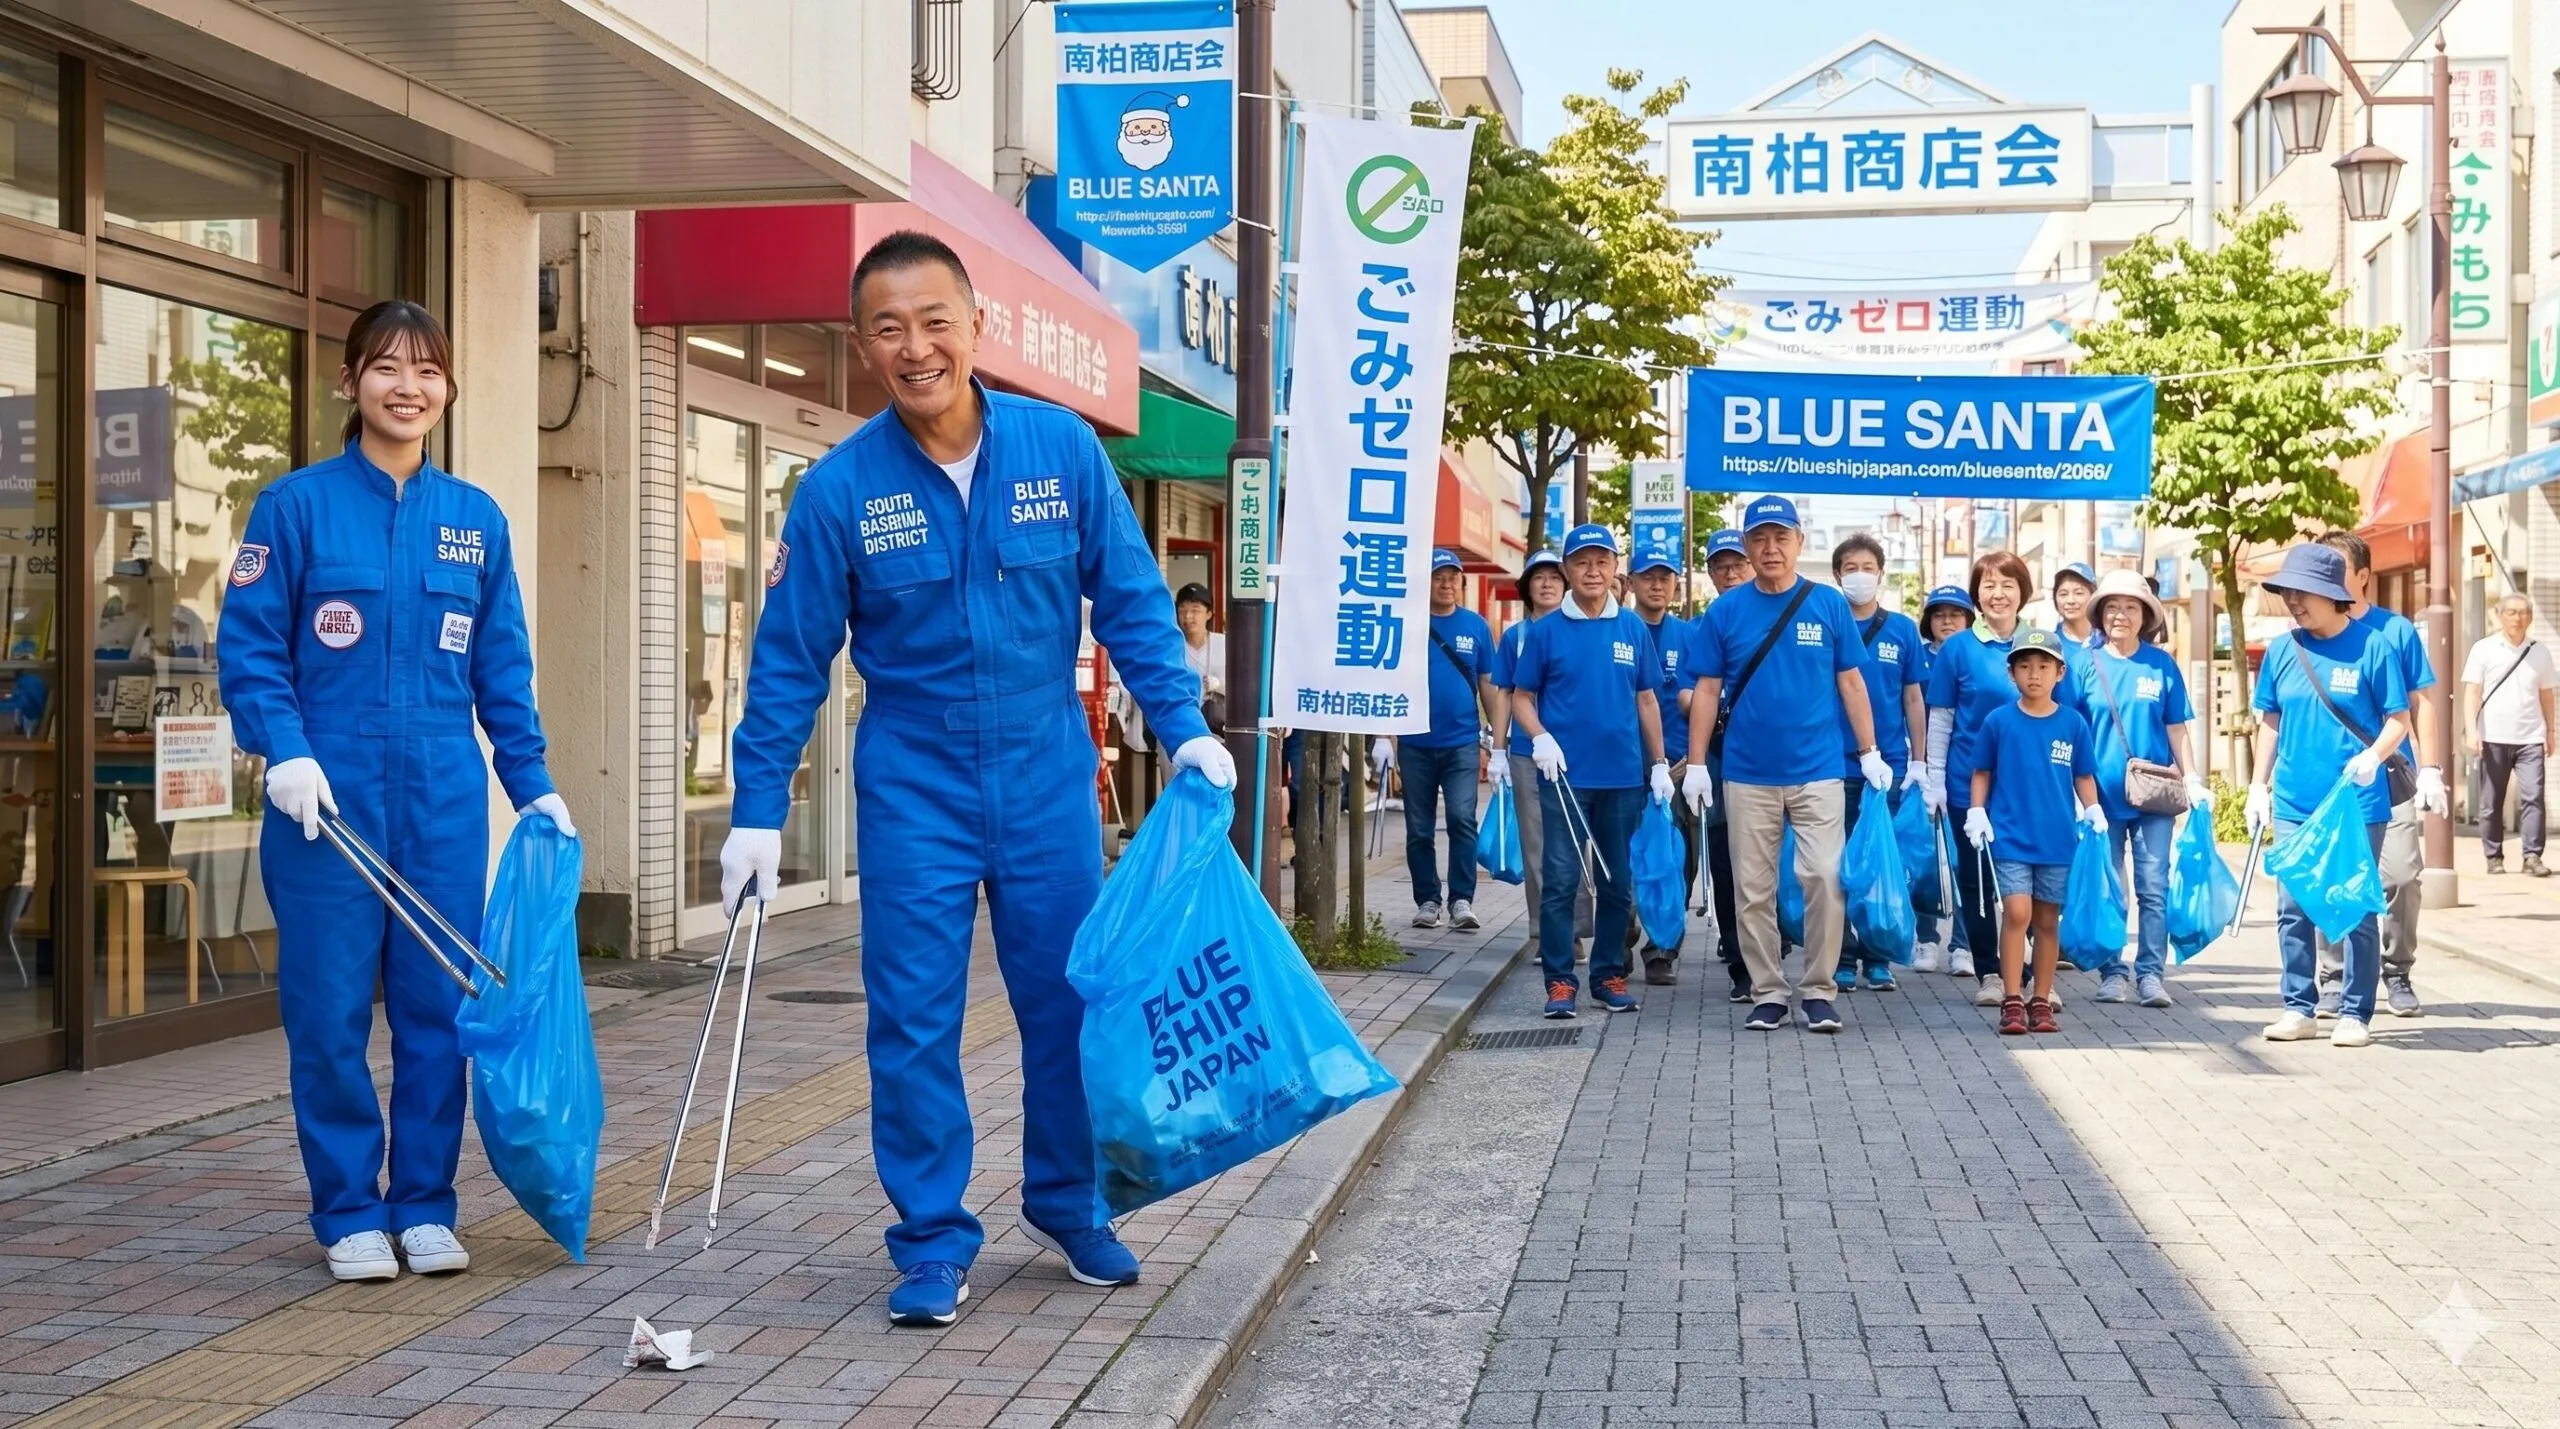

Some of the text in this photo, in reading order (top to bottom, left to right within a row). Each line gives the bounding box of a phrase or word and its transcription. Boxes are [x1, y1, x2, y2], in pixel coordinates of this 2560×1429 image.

[1064, 39, 1225, 74] 南柏商店会
[1692, 123, 2061, 197] 南柏商店会
[1069, 175, 1220, 200] BLUE SANTA
[1764, 294, 2024, 334] ごみゼロ運動
[1723, 396, 2115, 451] BLUE SANTA
[1335, 262, 1416, 671] ごみゼロ運動
[1014, 478, 1061, 501] BLUE
[1011, 500, 1070, 524] SANTA
[439, 526, 482, 546] BLUE
[863, 527, 929, 556] DISTRICT
[437, 544, 485, 567] SANTA
[1141, 937, 1242, 1040] BLUE
[1152, 983, 1254, 1075] SHIP
[1165, 1023, 1273, 1112] JAPAN
